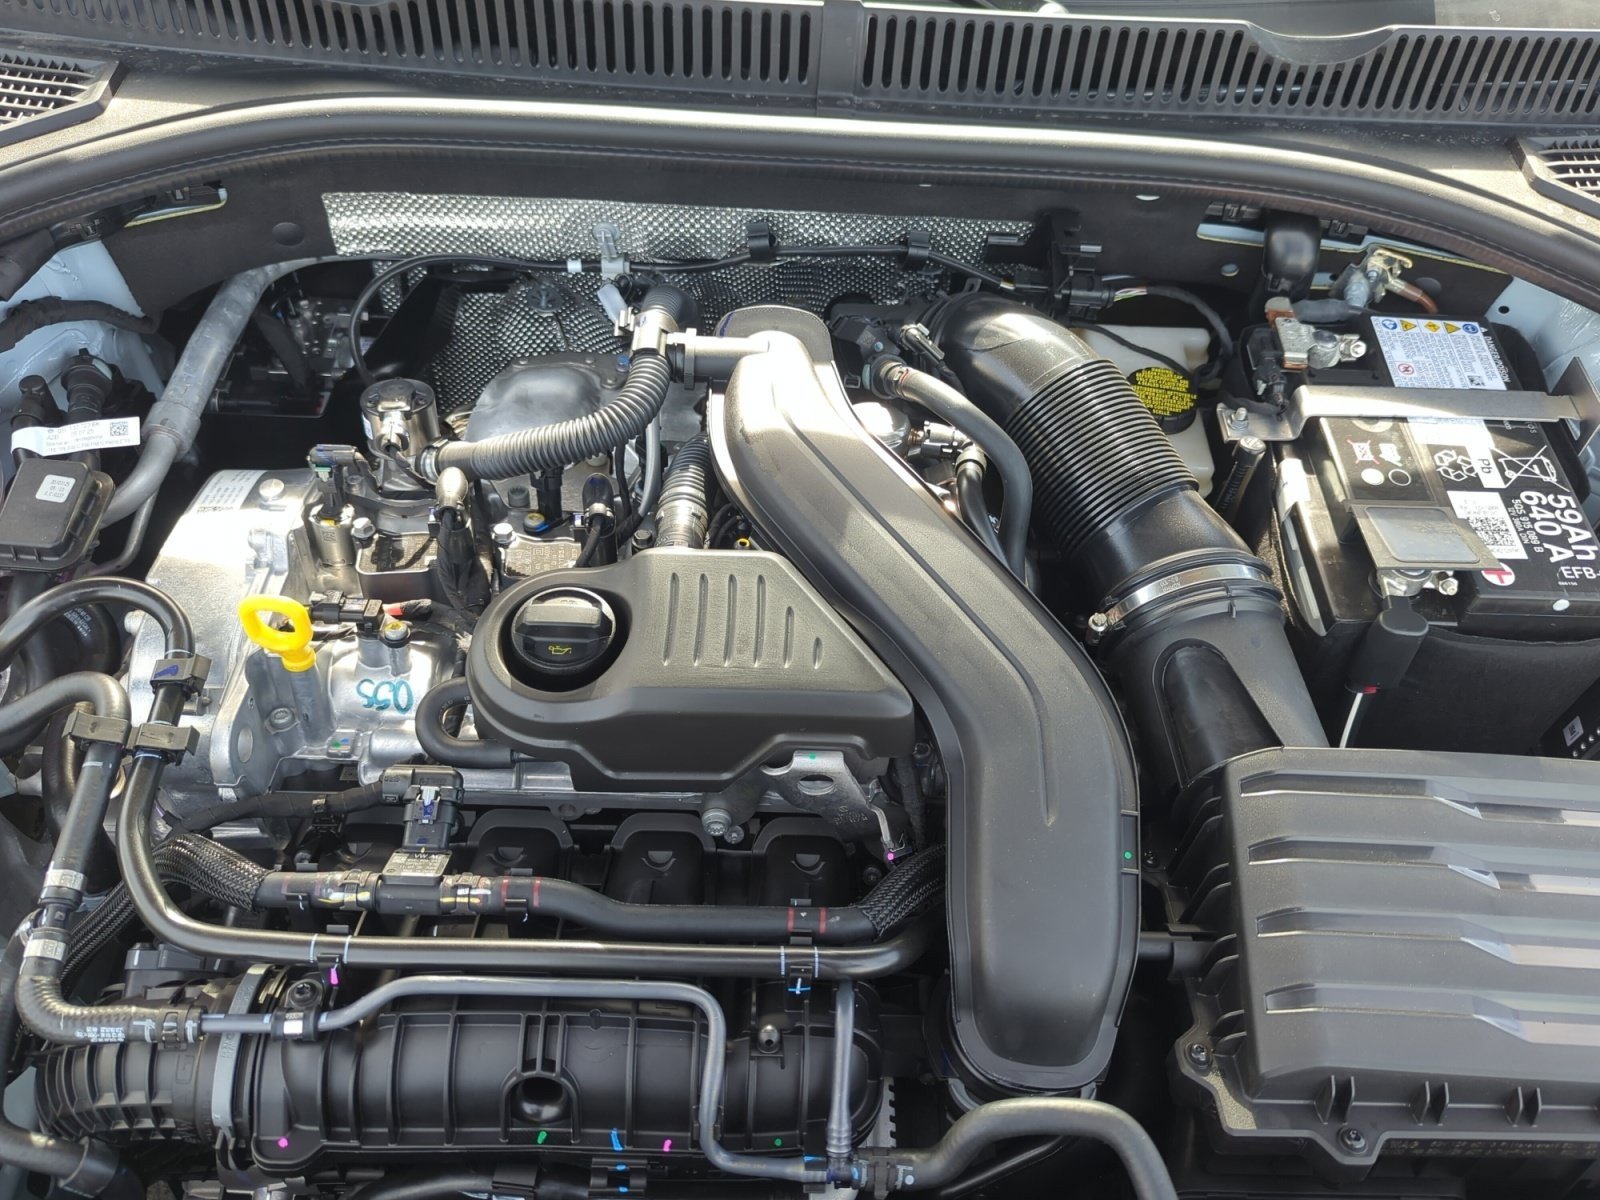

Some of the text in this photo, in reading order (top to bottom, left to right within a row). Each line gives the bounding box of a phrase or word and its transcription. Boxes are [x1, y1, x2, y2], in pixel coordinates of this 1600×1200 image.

[1478, 458, 1492, 474] Pb
[1520, 491, 1563, 536] 640
[1543, 543, 1574, 563] A
[1520, 516, 1534, 529] 915
[1527, 530, 1541, 544] 089
[1548, 494, 1599, 560] 59Ah
